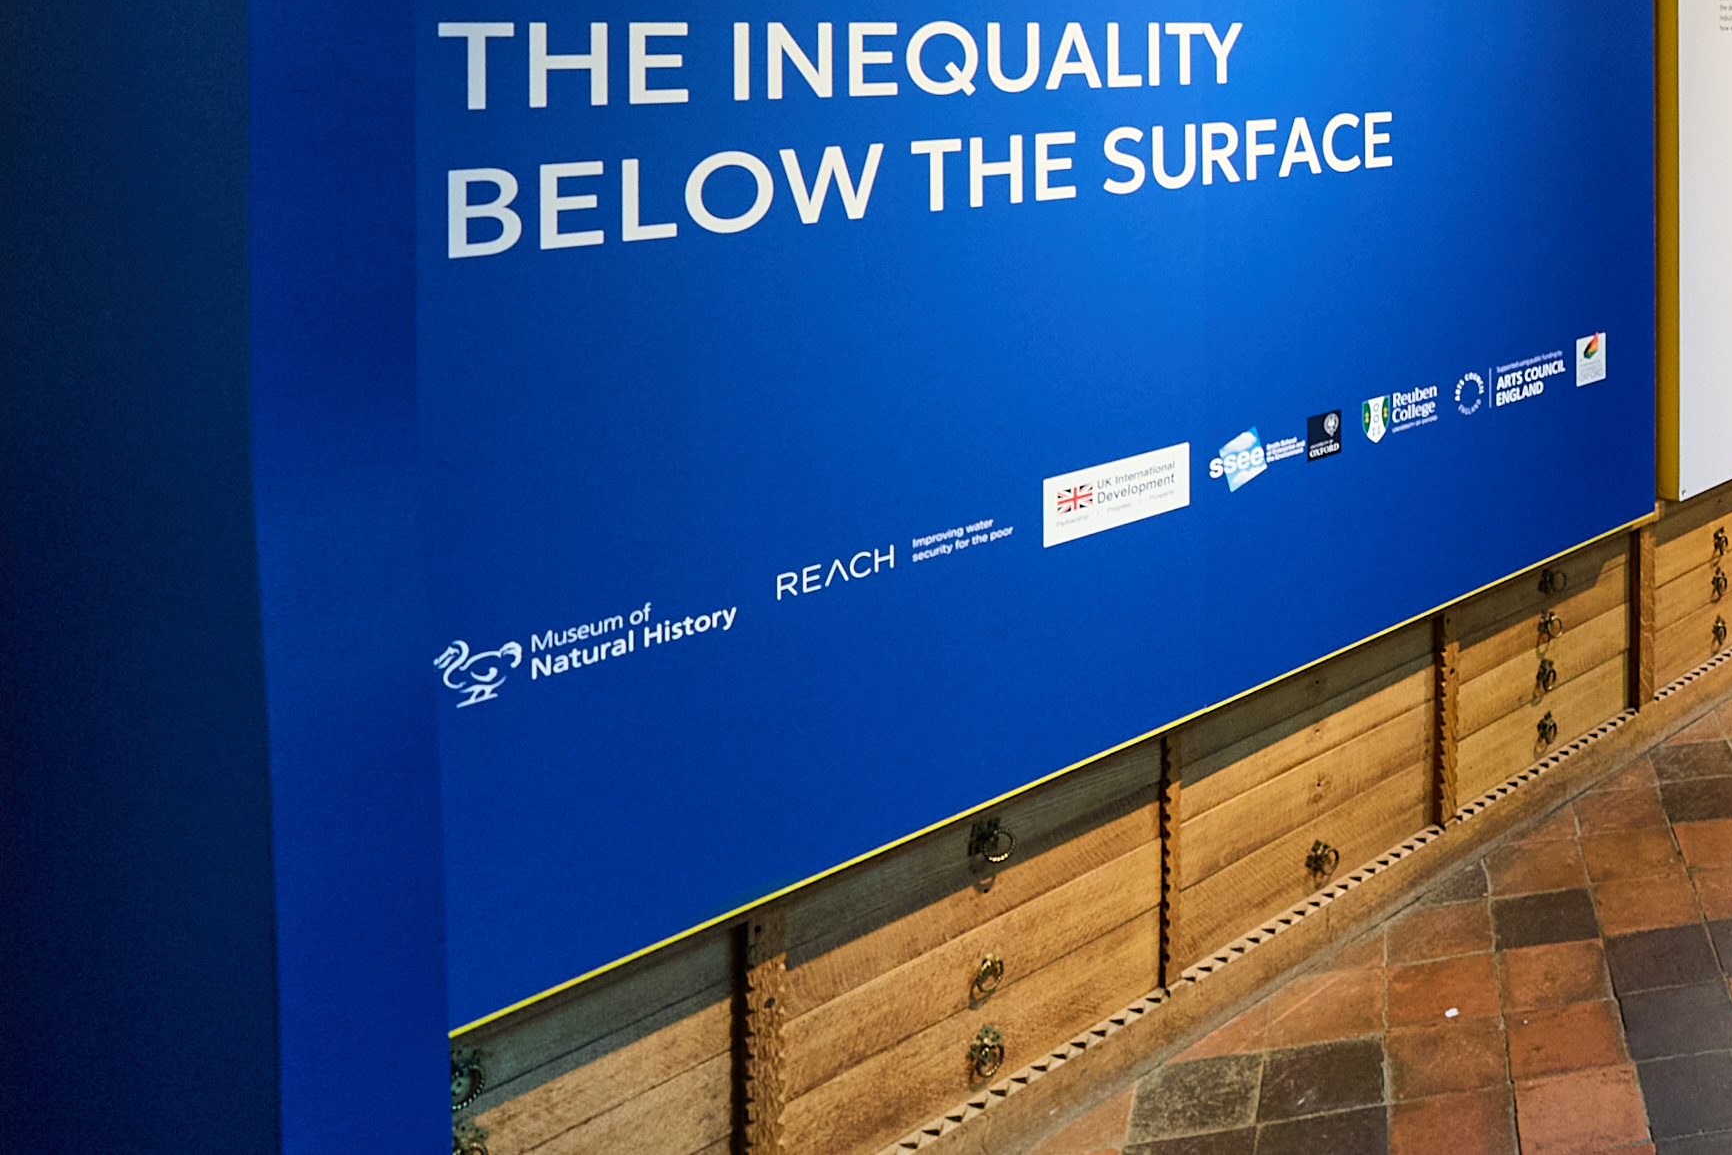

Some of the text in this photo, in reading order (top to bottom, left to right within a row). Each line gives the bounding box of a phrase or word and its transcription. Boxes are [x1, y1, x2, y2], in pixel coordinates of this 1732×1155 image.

[438, 20, 1243, 110] THE INEQUALITY
[448, 111, 1393, 259] BELOW THE SURFACE
[1496, 370, 1523, 391] ARTS
[1524, 359, 1566, 382] COUNCIL
[1392, 385, 1438, 408] Reuben
[1496, 380, 1544, 407] ENGLAND
[1392, 401, 1436, 423] College
[1209, 446, 1265, 479] ssee
[1309, 443, 1340, 458] OXFORD
[1097, 460, 1176, 490] UK International
[1097, 474, 1175, 504] Development
[912, 519, 994, 548] Improving water
[912, 526, 1014, 562] security for the poor
[776, 544, 895, 601] REACH
[531, 602, 652, 653] Museum of
[531, 607, 737, 680] Natural History
